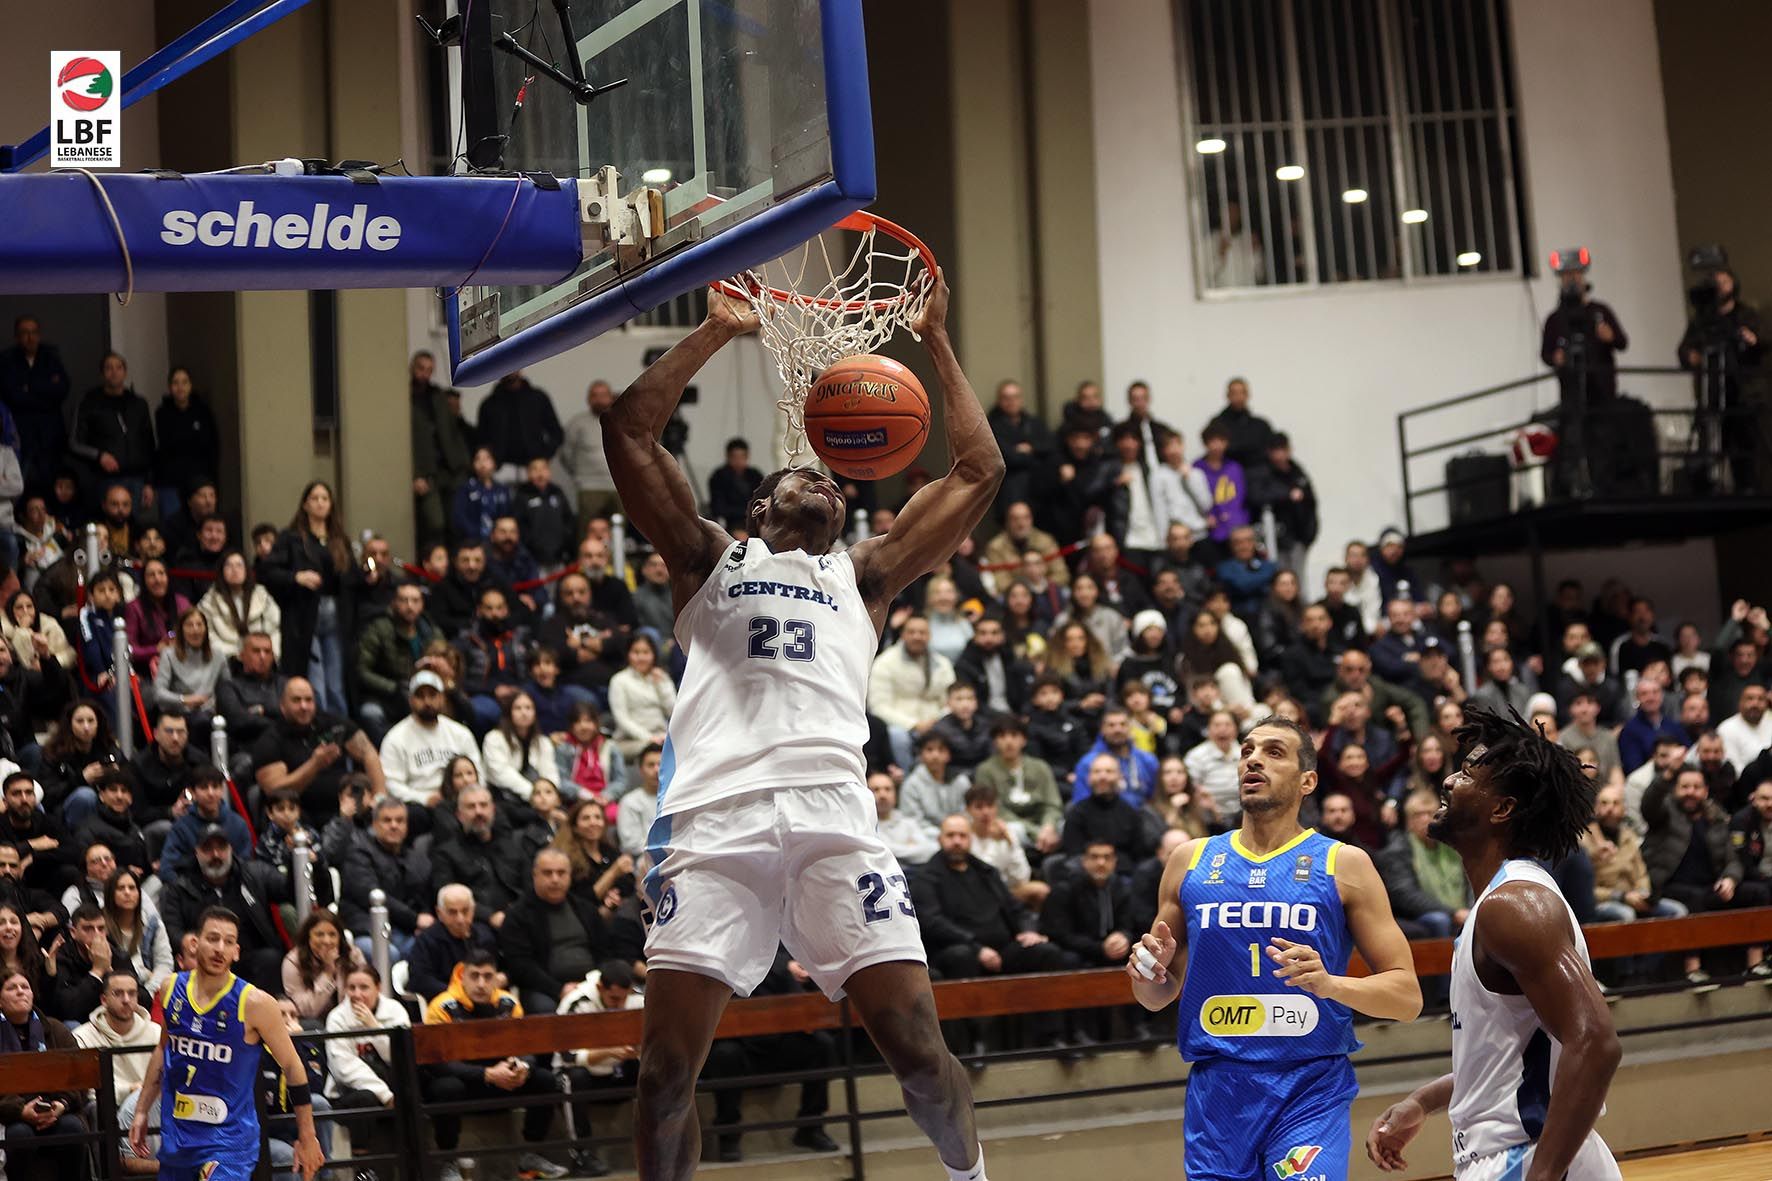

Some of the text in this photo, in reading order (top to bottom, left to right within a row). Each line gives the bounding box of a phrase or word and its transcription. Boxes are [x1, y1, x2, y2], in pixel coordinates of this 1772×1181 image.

[160, 200, 402, 251] schelde
[816, 381, 899, 404] SPALDING
[727, 581, 838, 612] CENTRAL
[747, 616, 816, 663] 23
[1248, 876, 1267, 885] BAR
[1250, 868, 1268, 876] MAK
[855, 871, 917, 926] 23
[1195, 901, 1317, 932] TECNO
[1248, 943, 1260, 977] 1
[1209, 1006, 1308, 1029] OMT Pay
[169, 1034, 233, 1064] TECNO
[185, 1064, 197, 1087] 1
